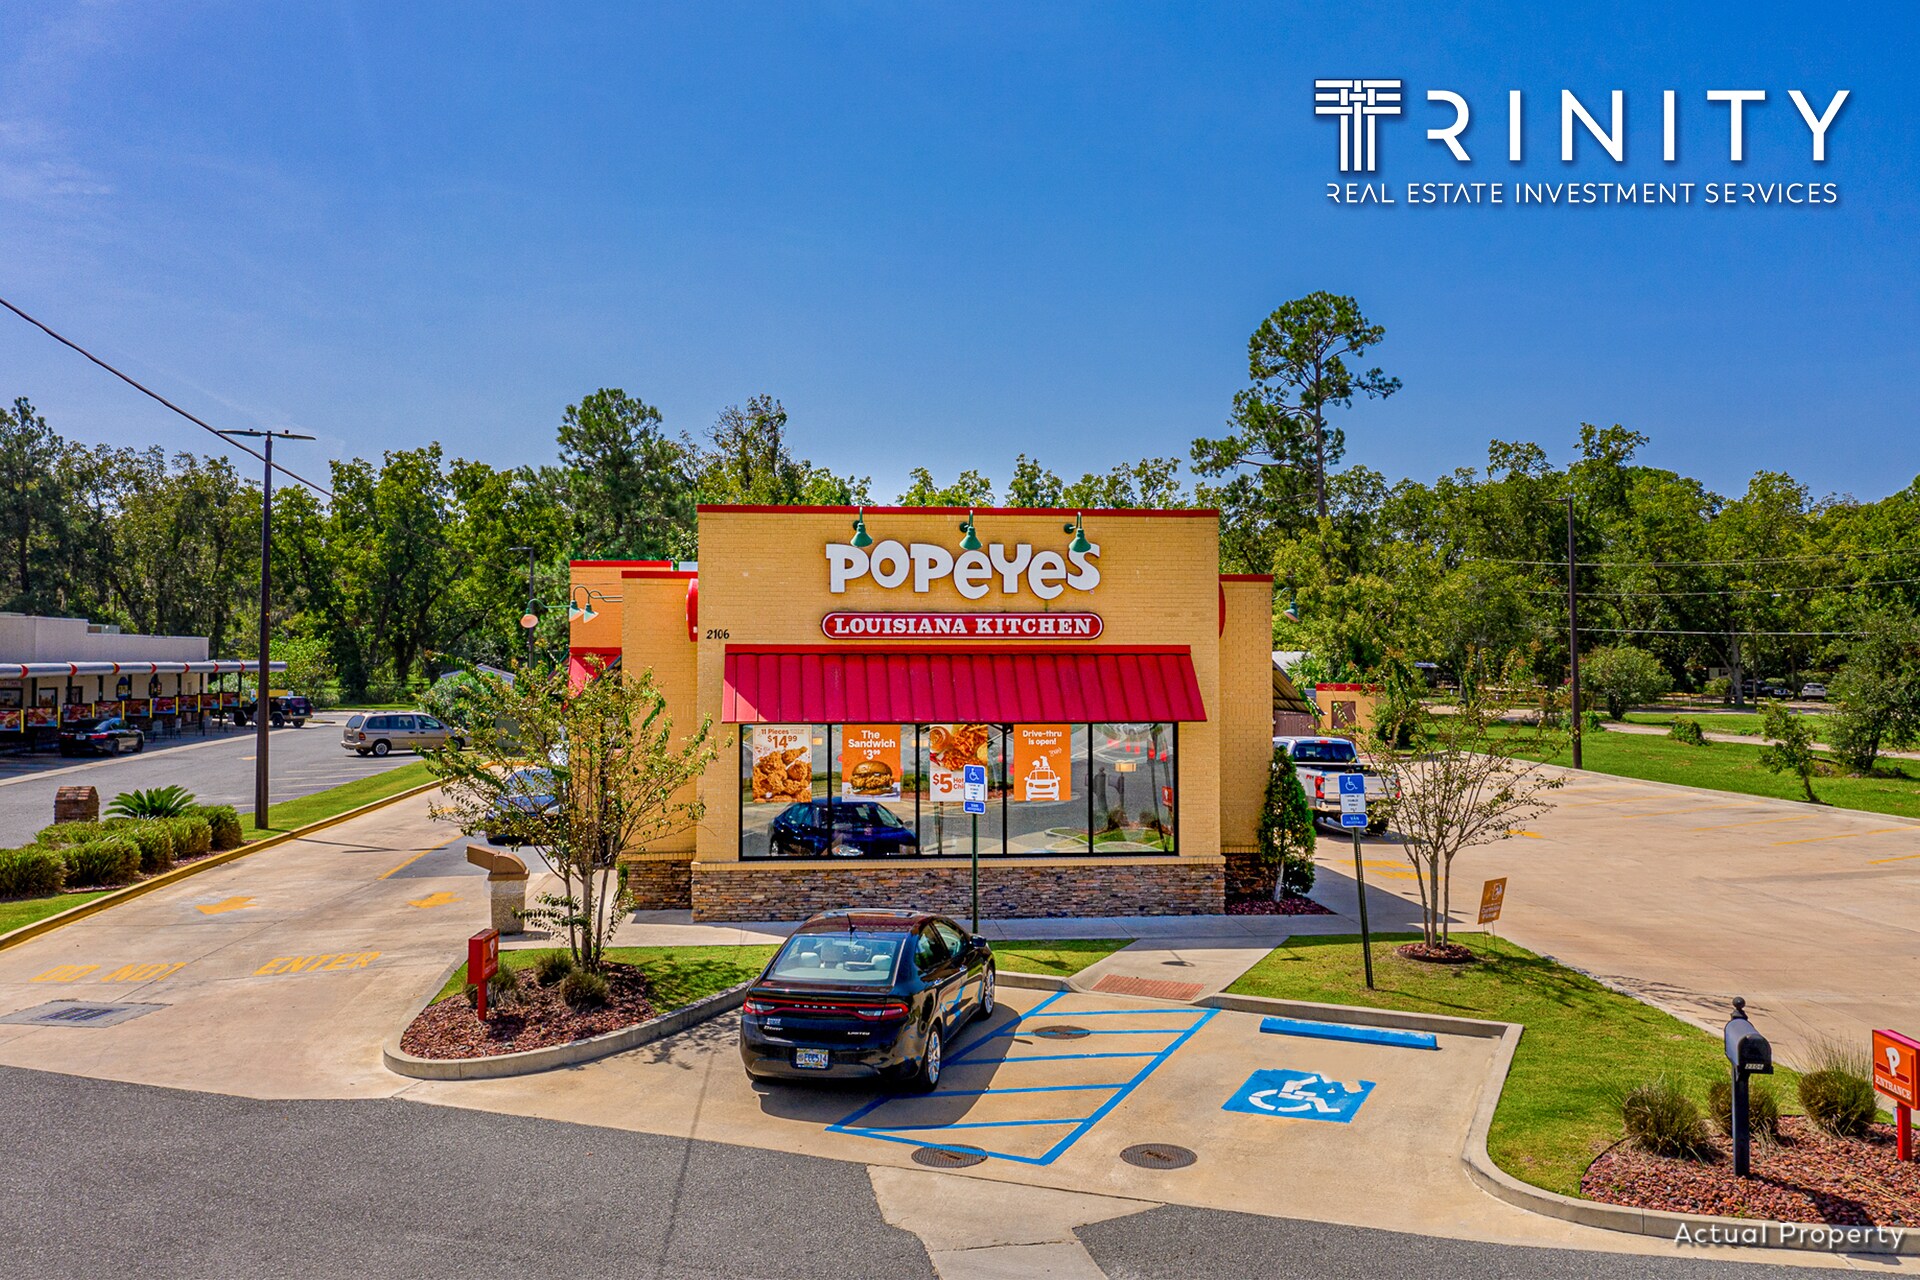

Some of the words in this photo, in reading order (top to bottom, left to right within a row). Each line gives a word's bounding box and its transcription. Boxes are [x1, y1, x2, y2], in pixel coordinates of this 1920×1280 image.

[834, 617, 968, 634] LOUISIANA
[975, 617, 1092, 634] KITCHEN
[706, 629, 730, 639] 2106
[861, 729, 880, 739] The
[1022, 729, 1063, 737] Drive-thru
[848, 738, 896, 748] Sandwich
[1028, 737, 1035, 745] is
[1035, 737, 1057, 746] open!
[932, 773, 953, 794] $5
[29, 964, 101, 982] DO
[101, 962, 188, 982] NOT
[252, 951, 382, 976] ENTER
[1885, 1046, 1901, 1078] P
[1874, 1073, 1912, 1102] ENTRANCE
